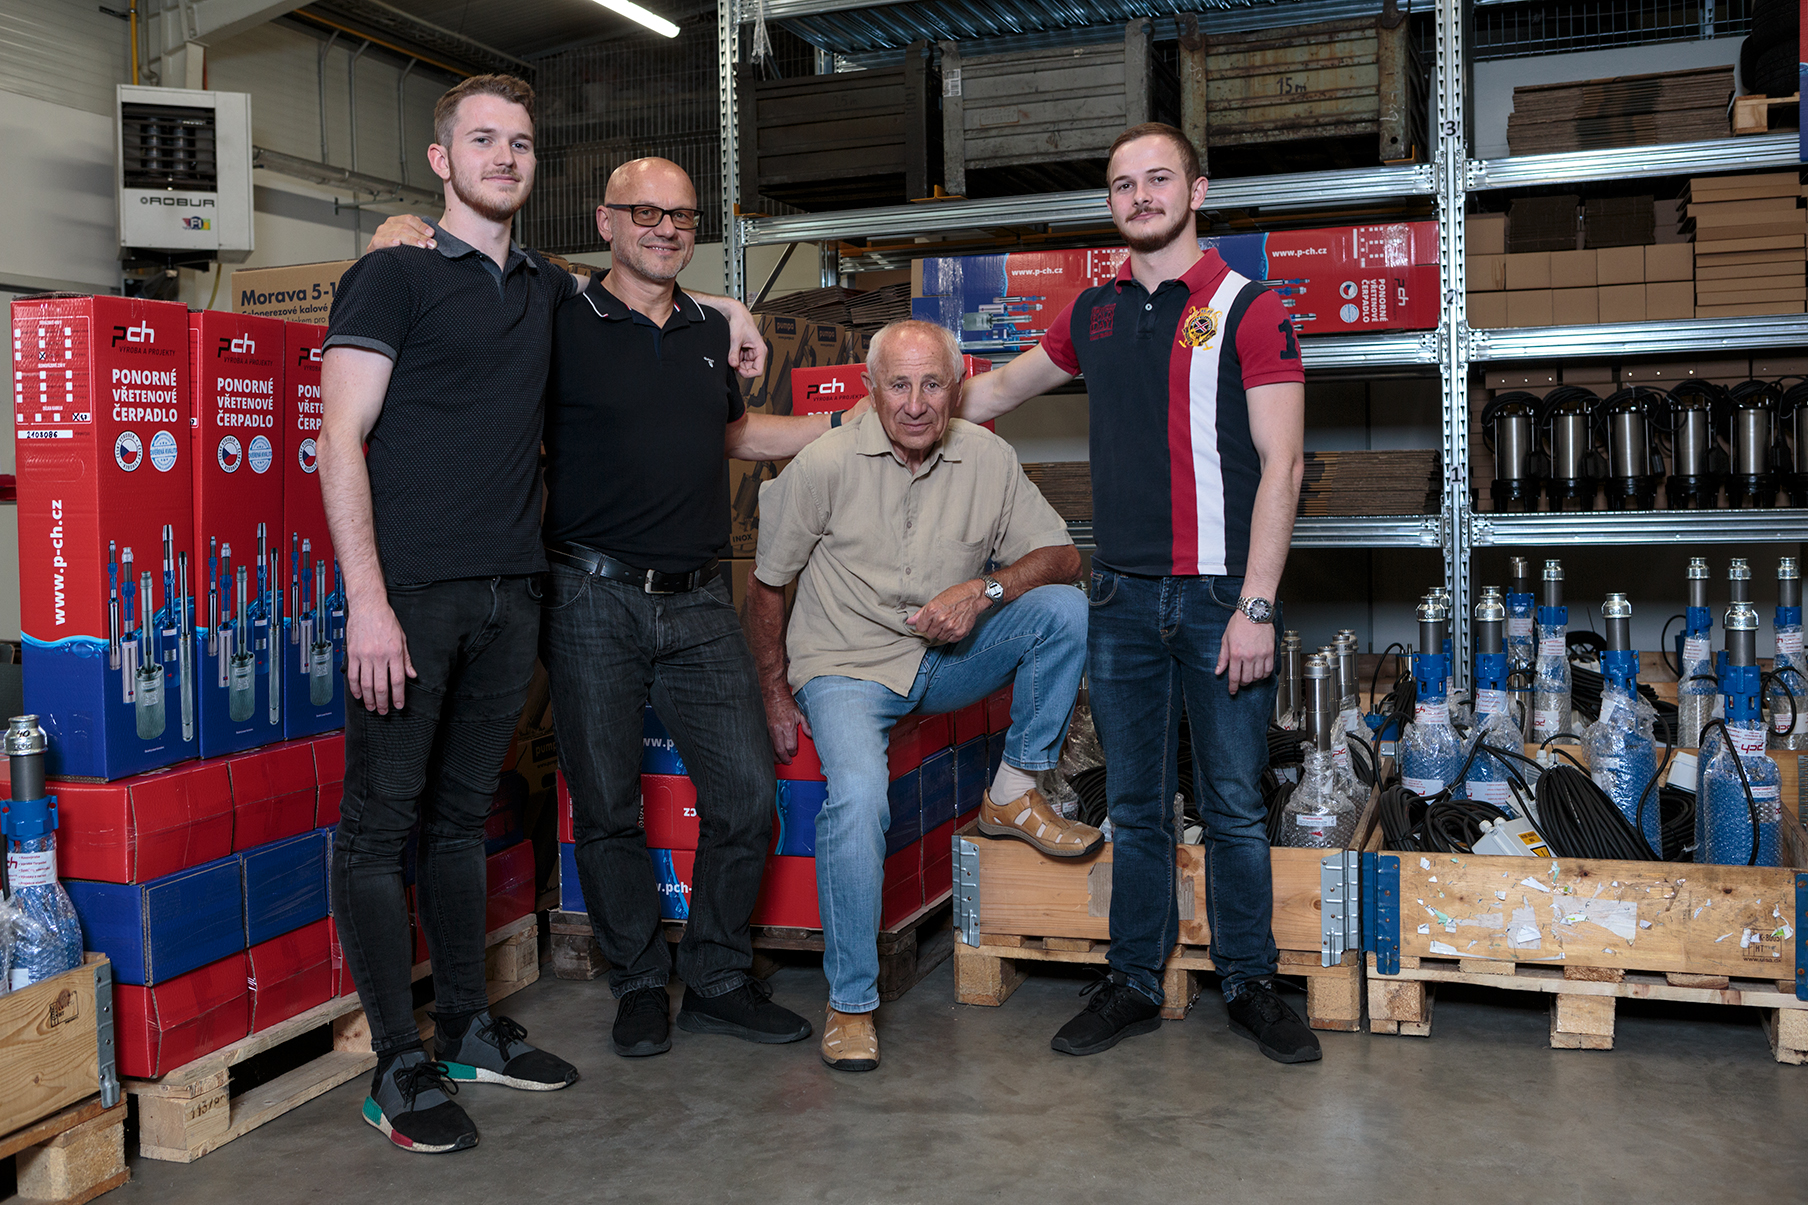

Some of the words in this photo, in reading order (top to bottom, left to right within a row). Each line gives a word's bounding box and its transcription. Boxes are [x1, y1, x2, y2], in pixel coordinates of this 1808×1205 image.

[1445, 120, 1457, 136] 3
[149, 196, 215, 208] ROBUR
[1271, 247, 1328, 258] www.p-ch.cz
[1011, 267, 1063, 277] www.p-ch.cz
[241, 289, 307, 307] Morava
[311, 281, 336, 301] 5-1
[1395, 278, 1409, 305] pch
[1447, 289, 1458, 304] 2
[299, 303, 328, 314] kalové
[1361, 279, 1370, 323] ČERPADLO
[1370, 278, 1379, 323] VŘETENOVÉ
[1378, 278, 1389, 323] PONORNÉ
[313, 316, 326, 325] pro
[776, 322, 794, 332] pumpa
[112, 320, 155, 348] pch
[1278, 319, 1298, 360] 1
[148, 348, 176, 356] PROJEKTY
[217, 333, 256, 358] pch
[298, 347, 324, 367] pc
[112, 368, 177, 387] PONORNÉ
[217, 377, 274, 394] PONORNÉ
[112, 386, 178, 404] VŘETENOVÉ
[807, 378, 845, 399] pch
[217, 394, 274, 410] VŘETENOVÉ
[298, 399, 323, 413] VŘETE
[112, 403, 178, 423] ČERPADLO
[217, 410, 274, 428] ČERPADLO
[297, 414, 322, 430] ČERP
[1451, 466, 1462, 482] 1
[732, 534, 753, 543] INOX
[49, 499, 68, 626] www.p-ch.cz
[535, 741, 557, 757] pump
